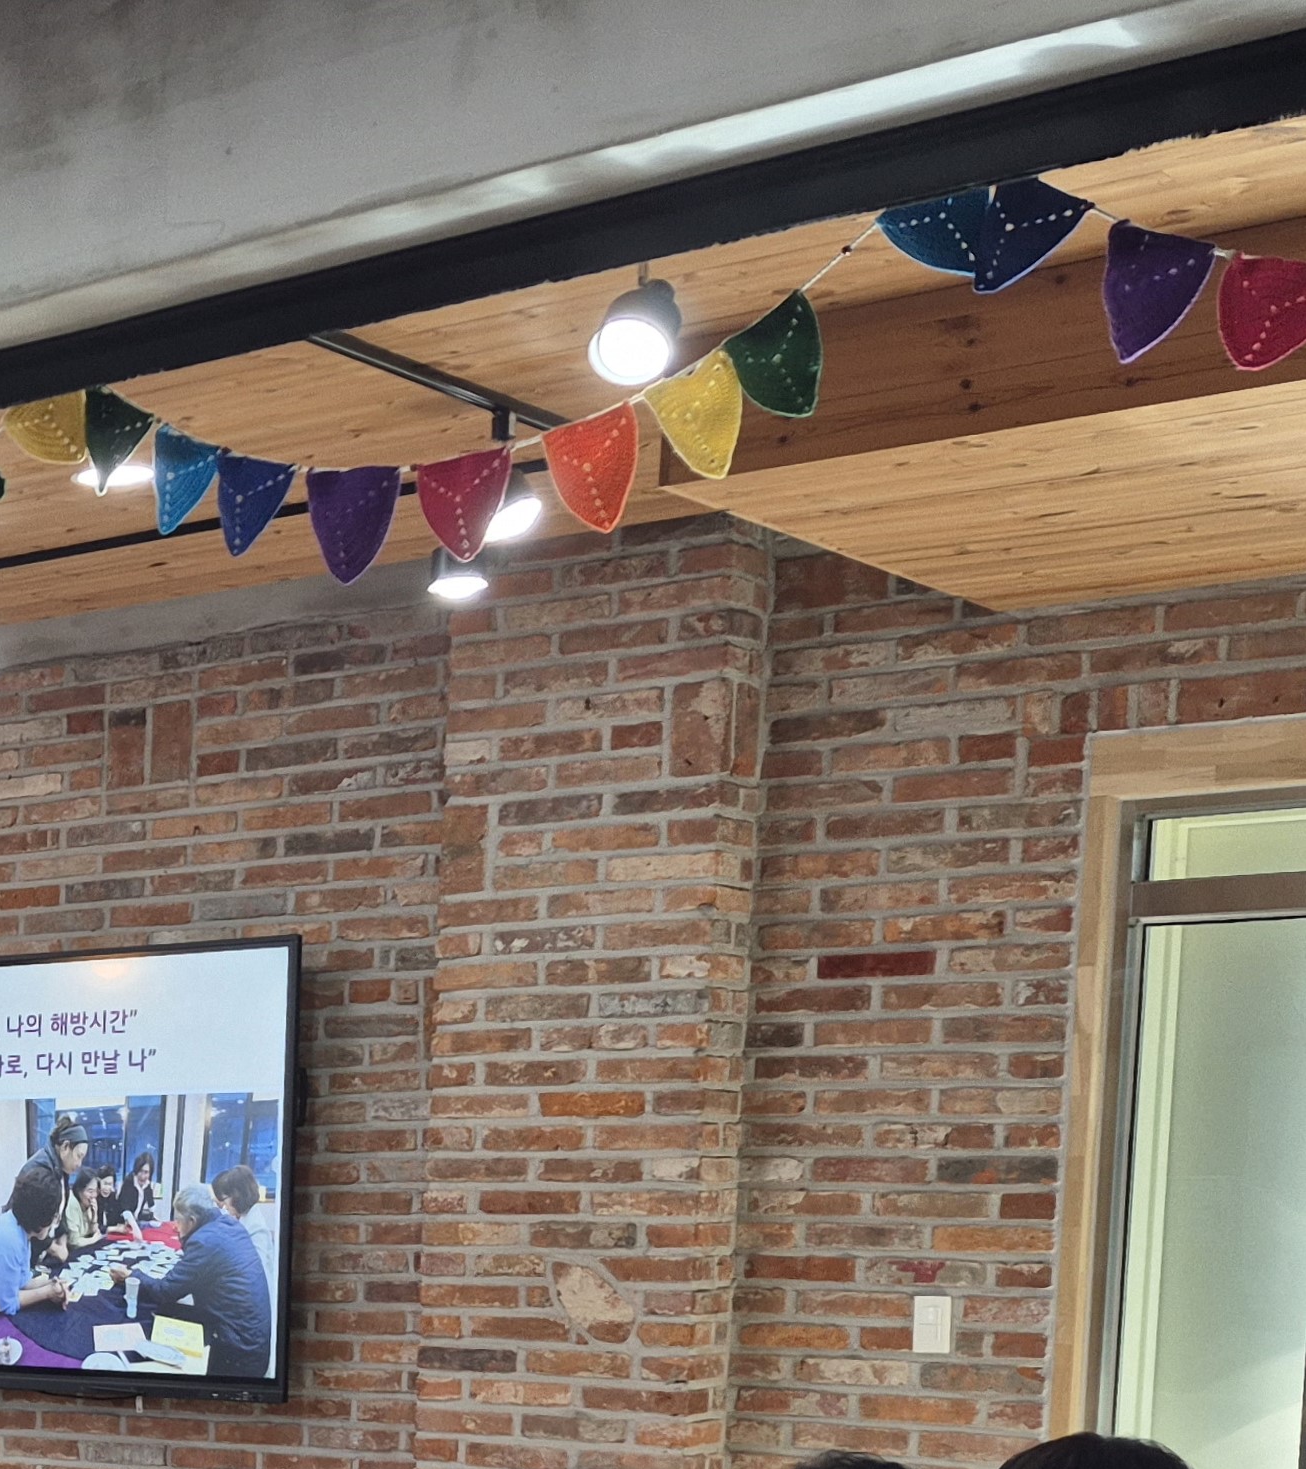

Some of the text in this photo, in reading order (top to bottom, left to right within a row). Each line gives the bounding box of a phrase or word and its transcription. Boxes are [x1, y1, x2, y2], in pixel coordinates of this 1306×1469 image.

[6, 1013, 43, 1038] 나의
[50, 1008, 138, 1036] 해방시간”
[36, 1051, 73, 1076] 다시
[81, 1049, 121, 1075] 만날
